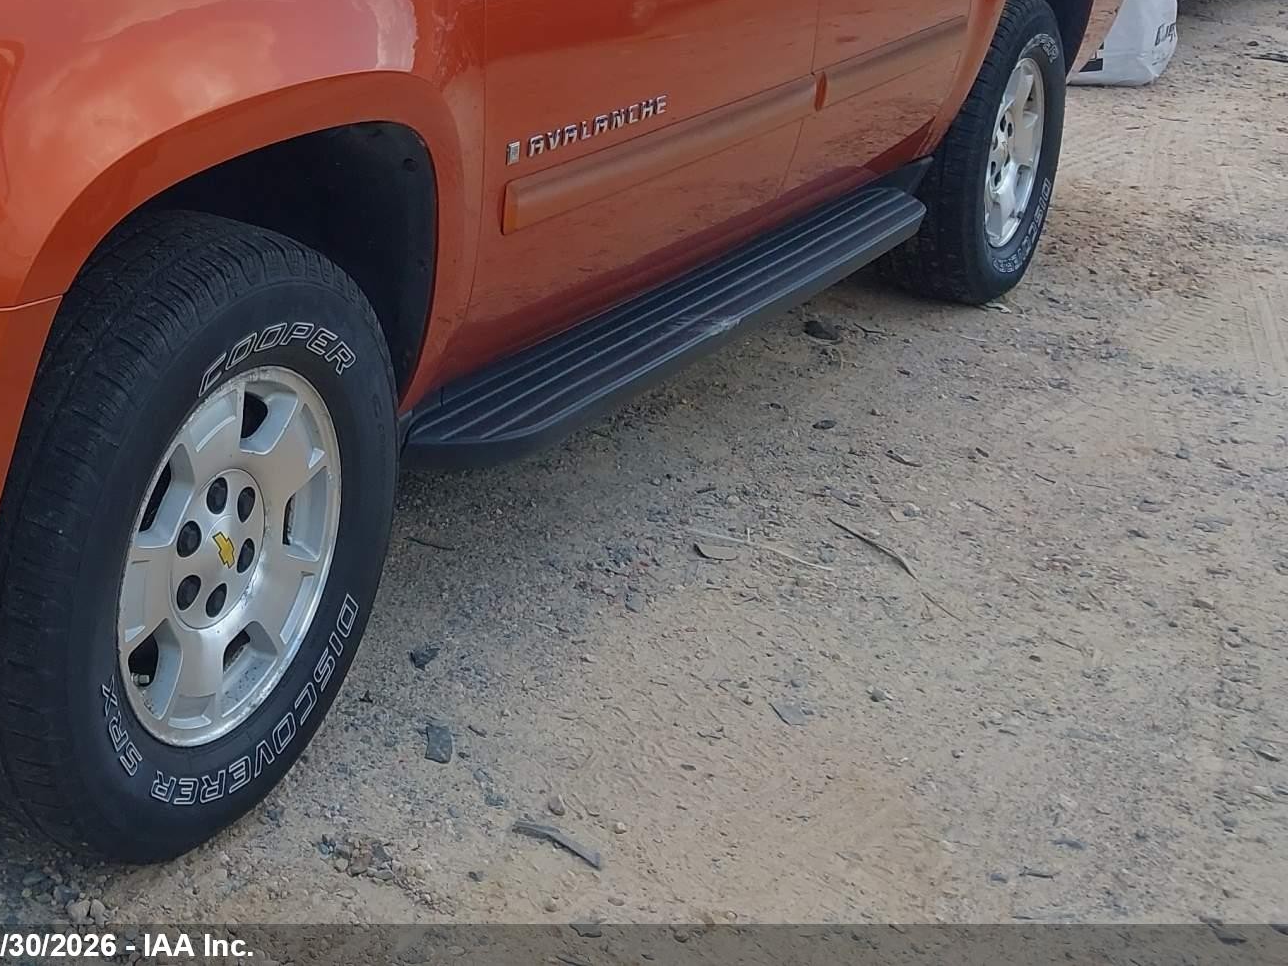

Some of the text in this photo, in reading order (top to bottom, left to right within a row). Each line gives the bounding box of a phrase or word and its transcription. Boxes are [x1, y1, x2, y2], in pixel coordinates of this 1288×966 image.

[528, 94, 667, 157] AVALANCHE
[198, 322, 356, 398] COOPER
[100, 593, 360, 806] DISCOVERER SRX
